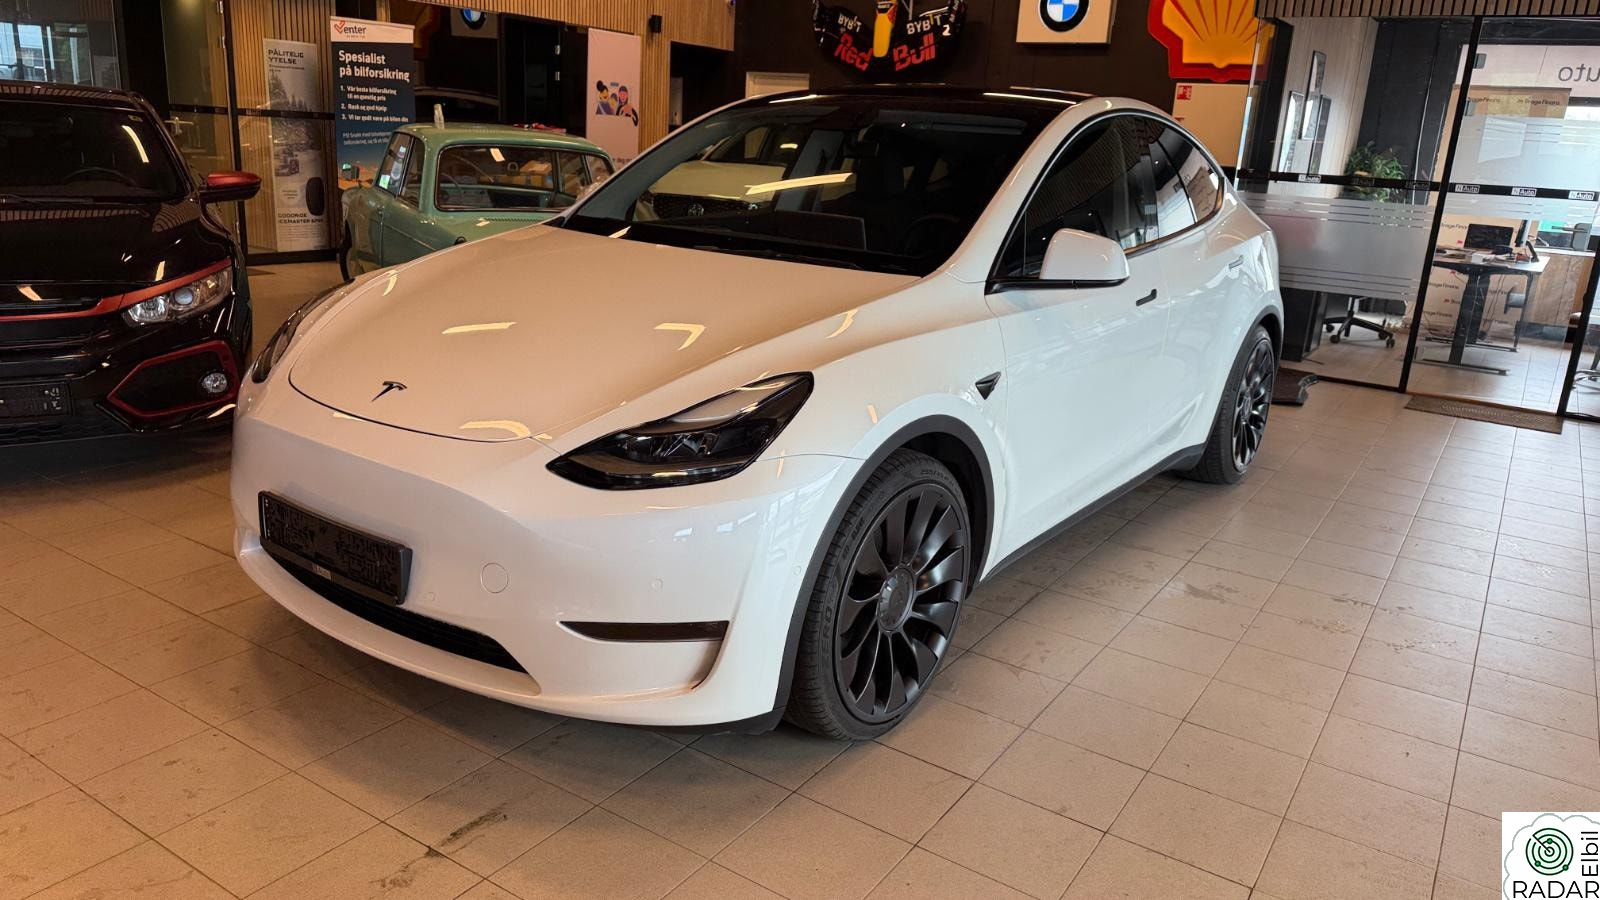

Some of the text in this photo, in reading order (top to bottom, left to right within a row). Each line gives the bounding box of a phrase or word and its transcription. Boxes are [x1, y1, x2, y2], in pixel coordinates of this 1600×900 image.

[942, 25, 951, 36] 2
[268, 48, 304, 58] PÅLITELIG
[834, 32, 936, 71] Red Bull
[268, 57, 297, 65] YTELSE
[338, 50, 386, 65] Spesialist
[339, 65, 410, 83] på bilforsikring
[369, 87, 397, 95] bilforsikring
